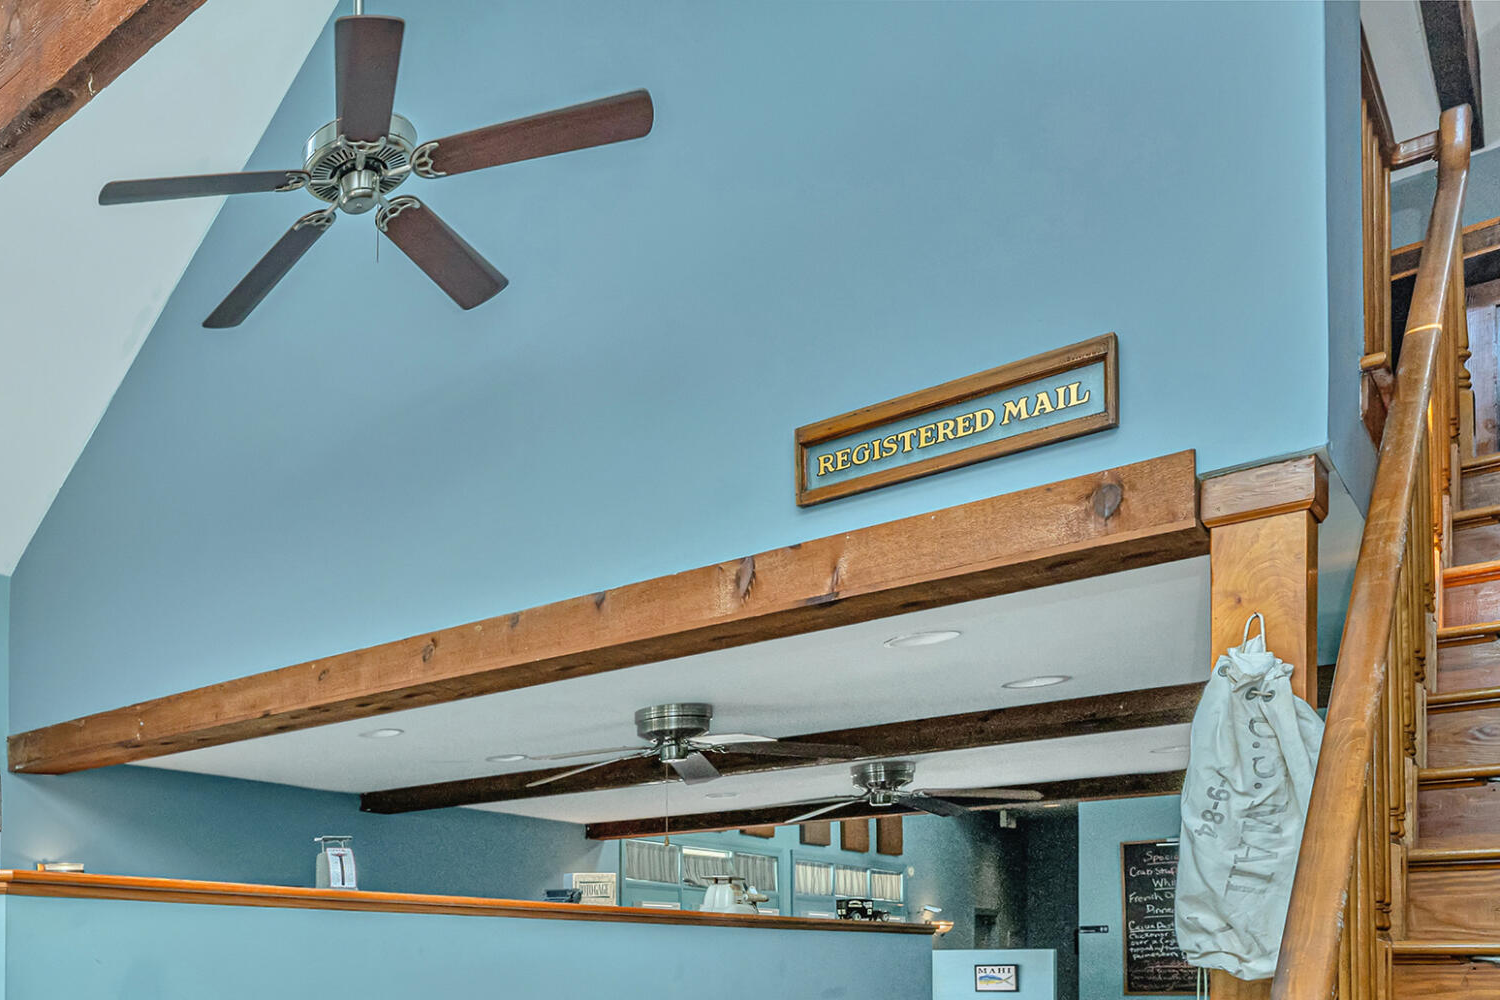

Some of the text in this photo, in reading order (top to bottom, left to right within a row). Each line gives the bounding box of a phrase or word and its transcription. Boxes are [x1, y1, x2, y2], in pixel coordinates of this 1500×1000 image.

[816, 381, 1091, 477] REGISTERED MAIL
[1143, 850, 1180, 864] Specia
[1154, 867, 1178, 876] Stuf
[1151, 878, 1176, 888] Whi
[1146, 904, 1174, 914] Dinne
